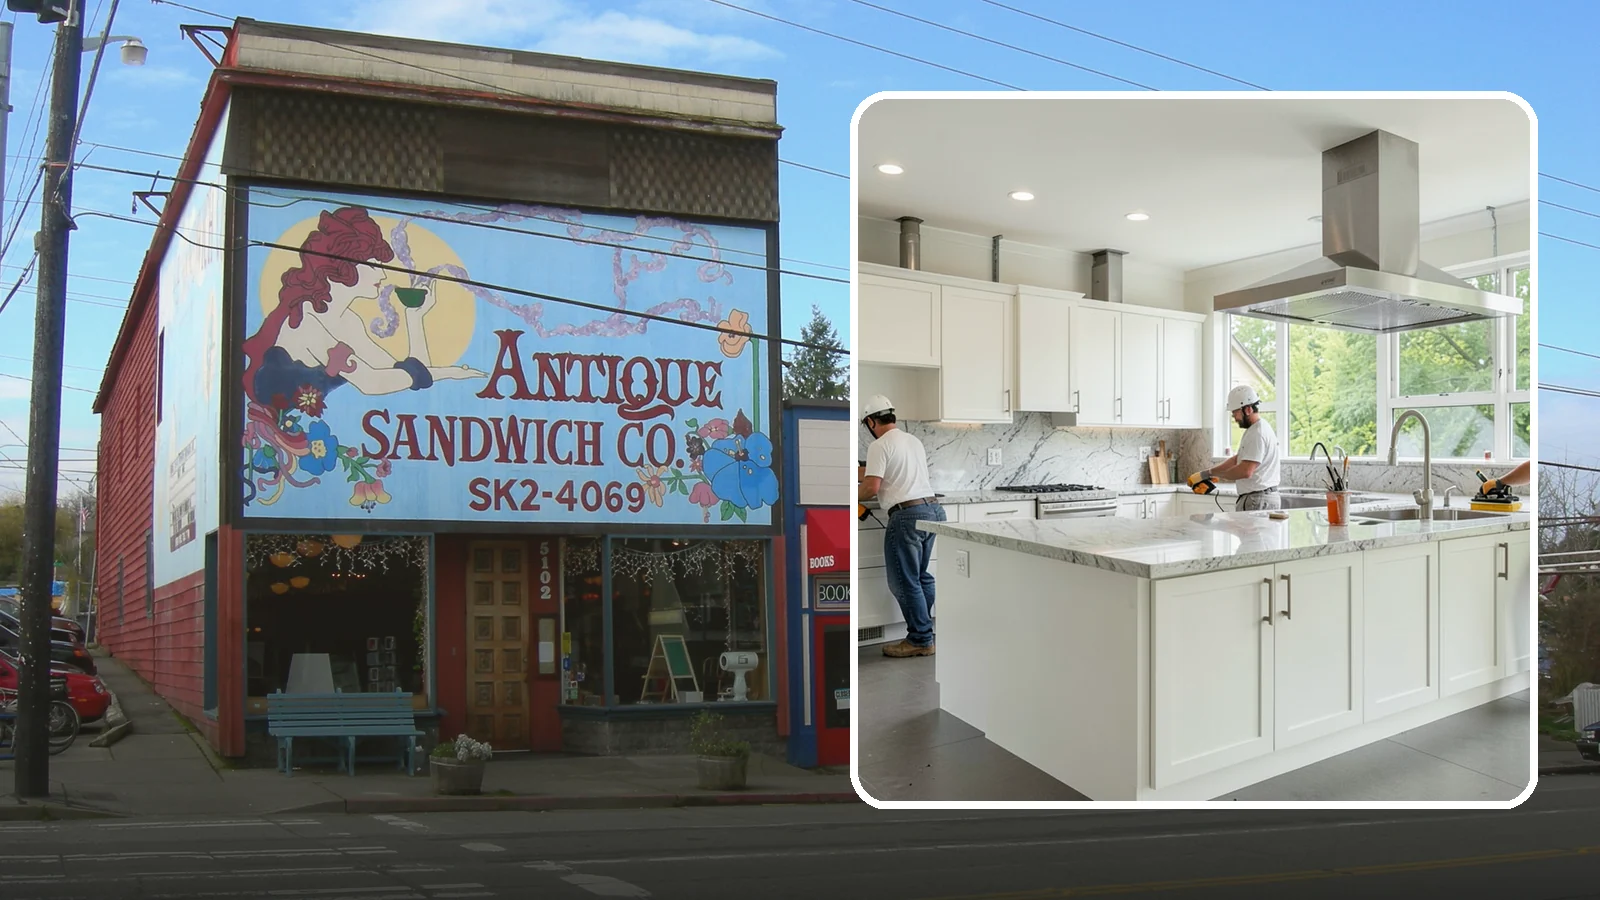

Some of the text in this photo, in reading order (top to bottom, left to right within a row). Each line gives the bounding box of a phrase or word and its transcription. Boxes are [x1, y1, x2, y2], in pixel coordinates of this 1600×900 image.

[361, 409, 685, 468] SANDWICH CO.
[469, 478, 645, 513] SK2-4069
[540, 541, 551, 600] 5102
[809, 555, 834, 569] BOOKS
